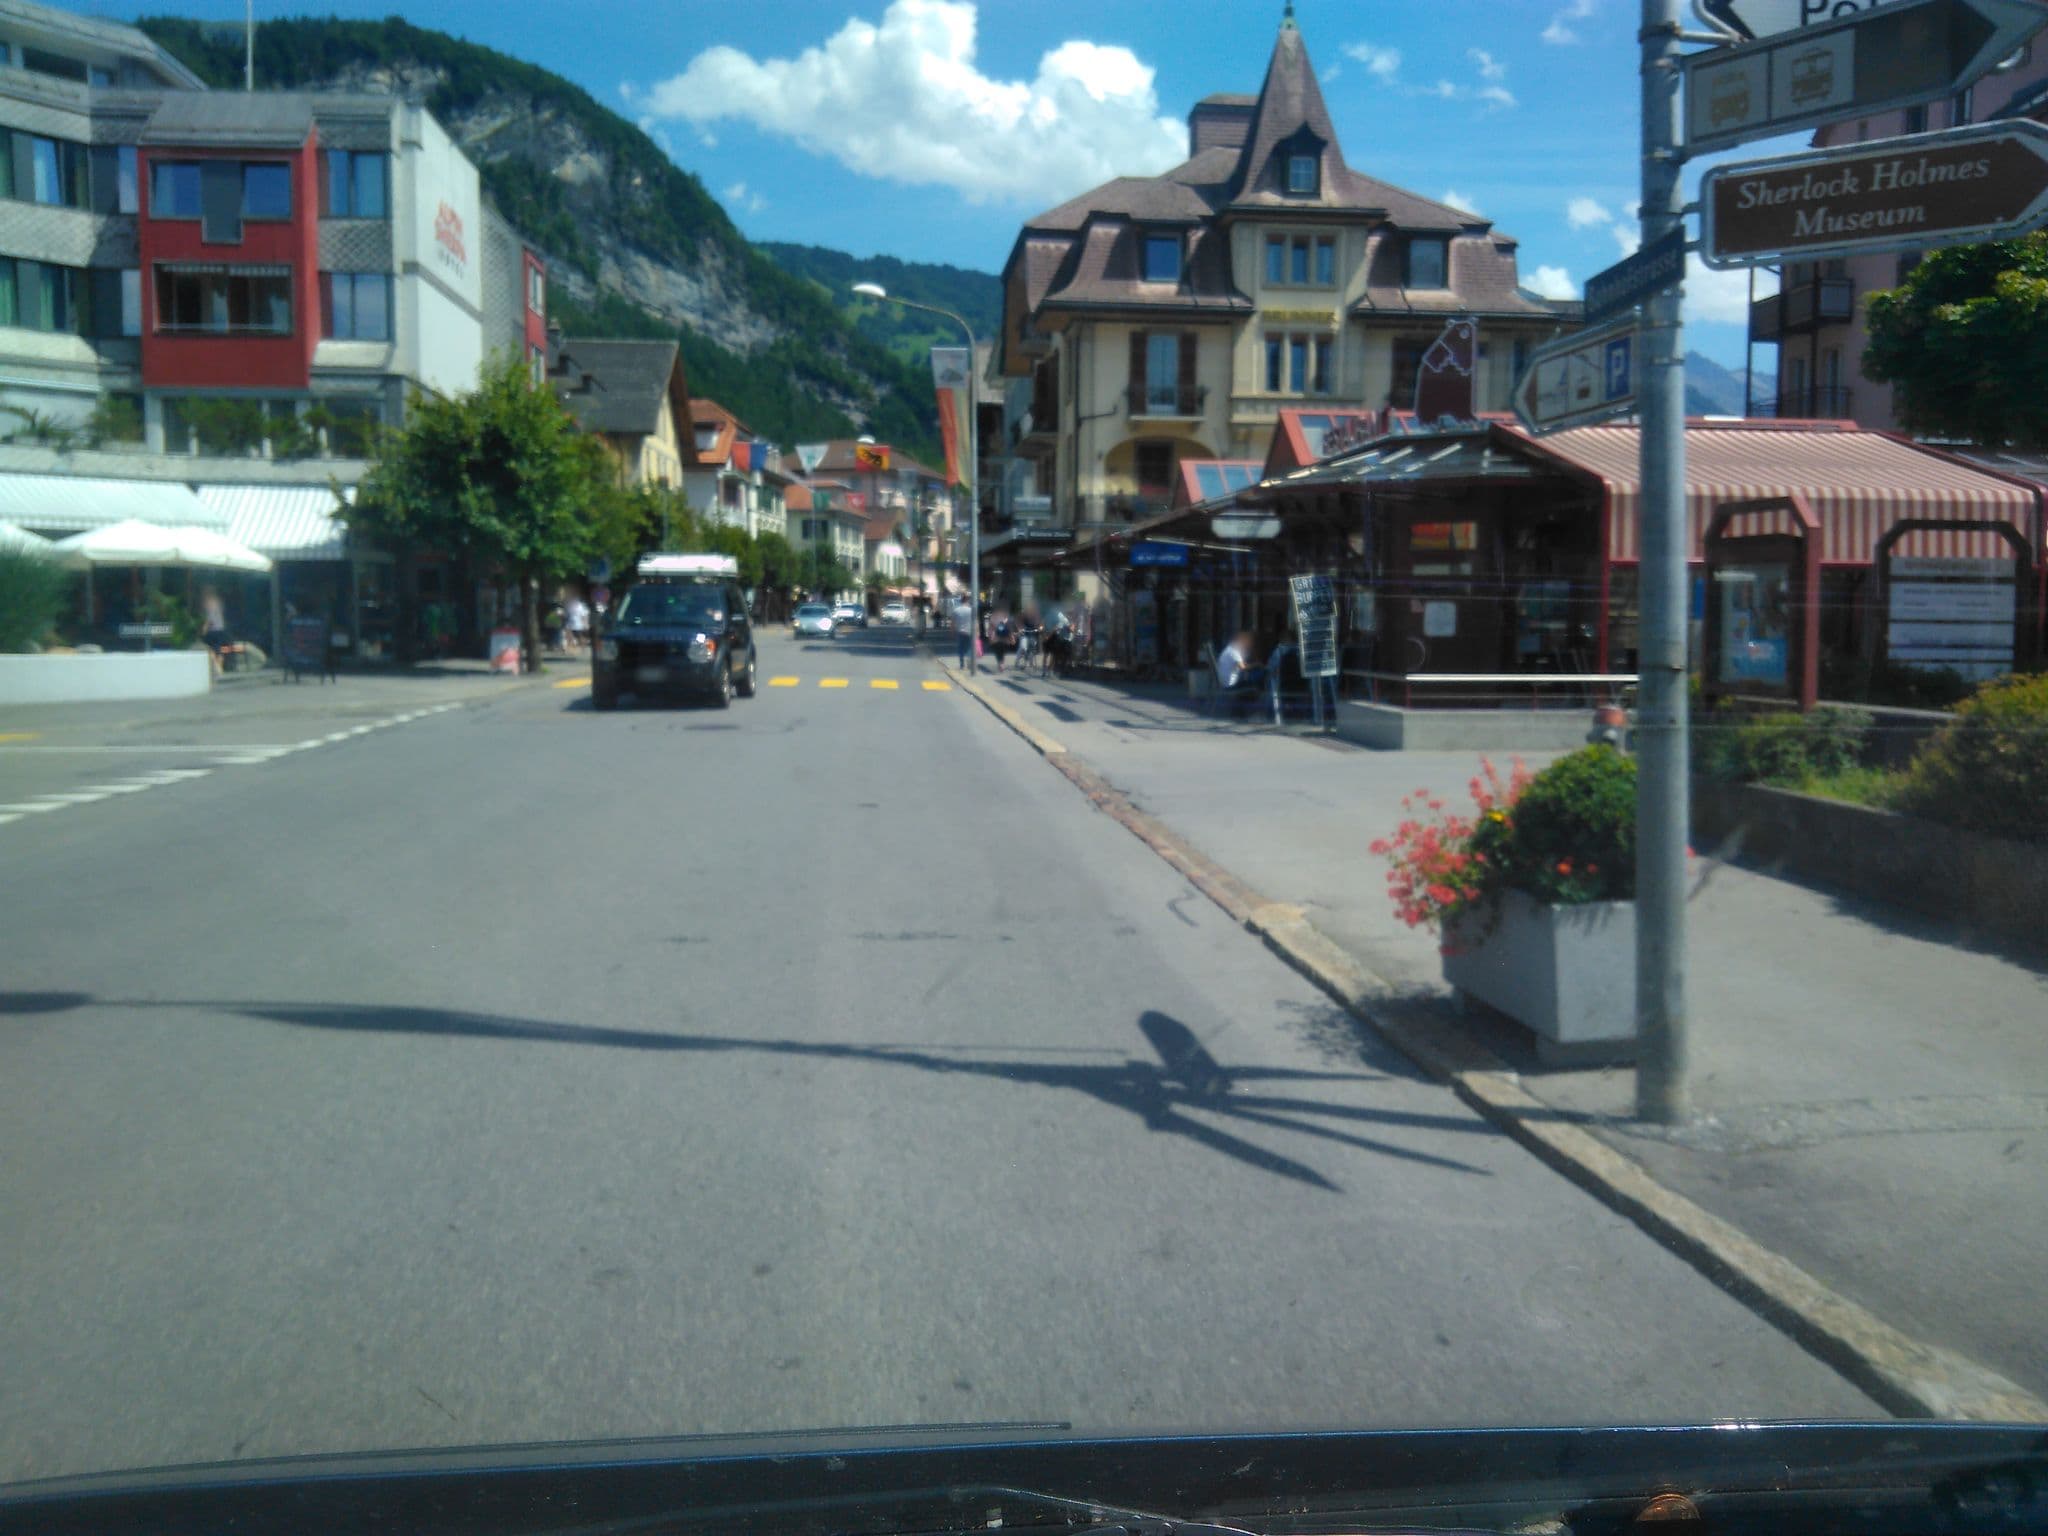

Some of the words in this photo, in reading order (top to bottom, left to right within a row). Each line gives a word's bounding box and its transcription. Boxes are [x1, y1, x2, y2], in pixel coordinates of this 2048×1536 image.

[1737, 173, 1859, 209] Sherlock
[1869, 158, 1990, 192] Holmes
[1792, 205, 1926, 237] Museum
[1611, 347, 1626, 394] P
